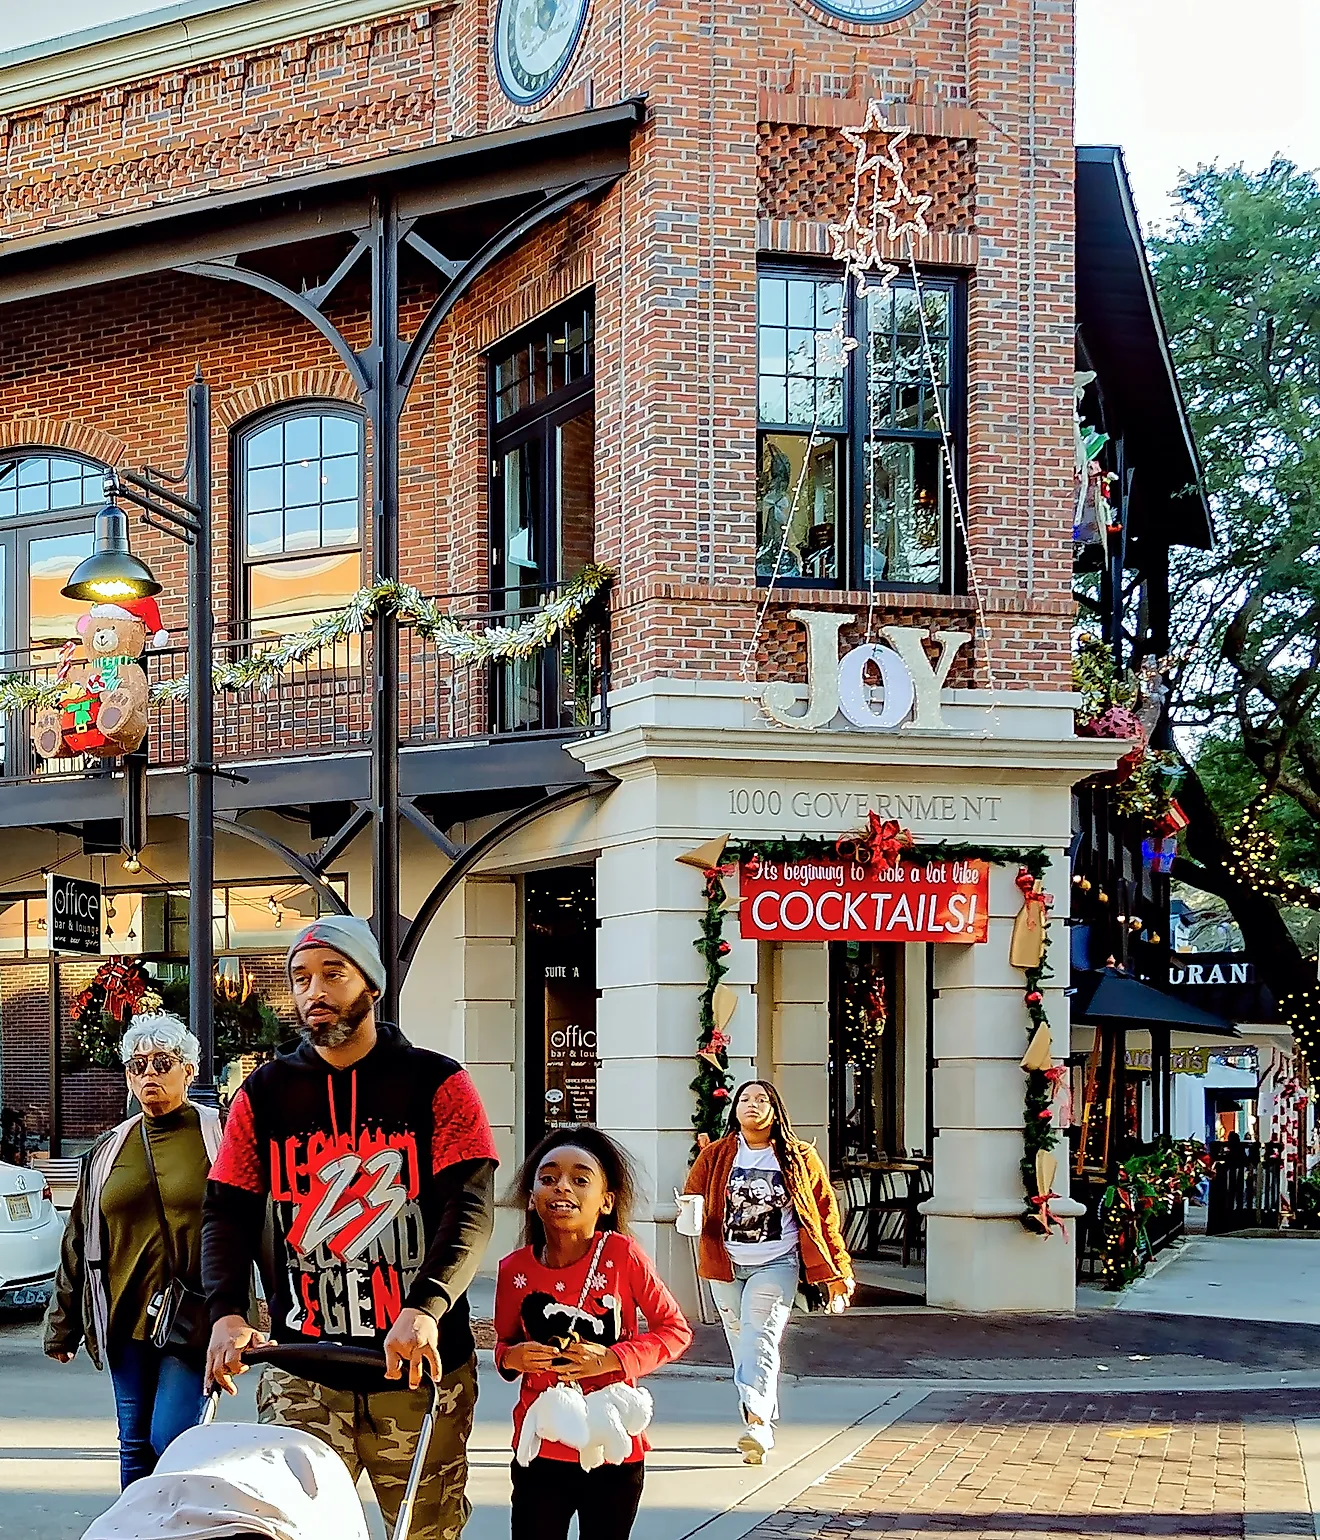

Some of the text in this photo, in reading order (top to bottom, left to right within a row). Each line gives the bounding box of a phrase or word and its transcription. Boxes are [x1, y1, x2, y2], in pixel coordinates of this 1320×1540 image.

[761, 609, 972, 731] JOY
[729, 789, 1002, 821] 1000 GOVERNMENT
[753, 860, 980, 887] It's beginning to ook a lot like
[54, 881, 99, 920] office
[751, 890, 978, 934] COCKTAILS!
[54, 917, 99, 937] bar & lounge
[545, 966, 567, 978] SUITE
[551, 1025, 597, 1047] offic
[551, 1050, 597, 1058] bar & lou
[297, 1148, 408, 1263] 23
